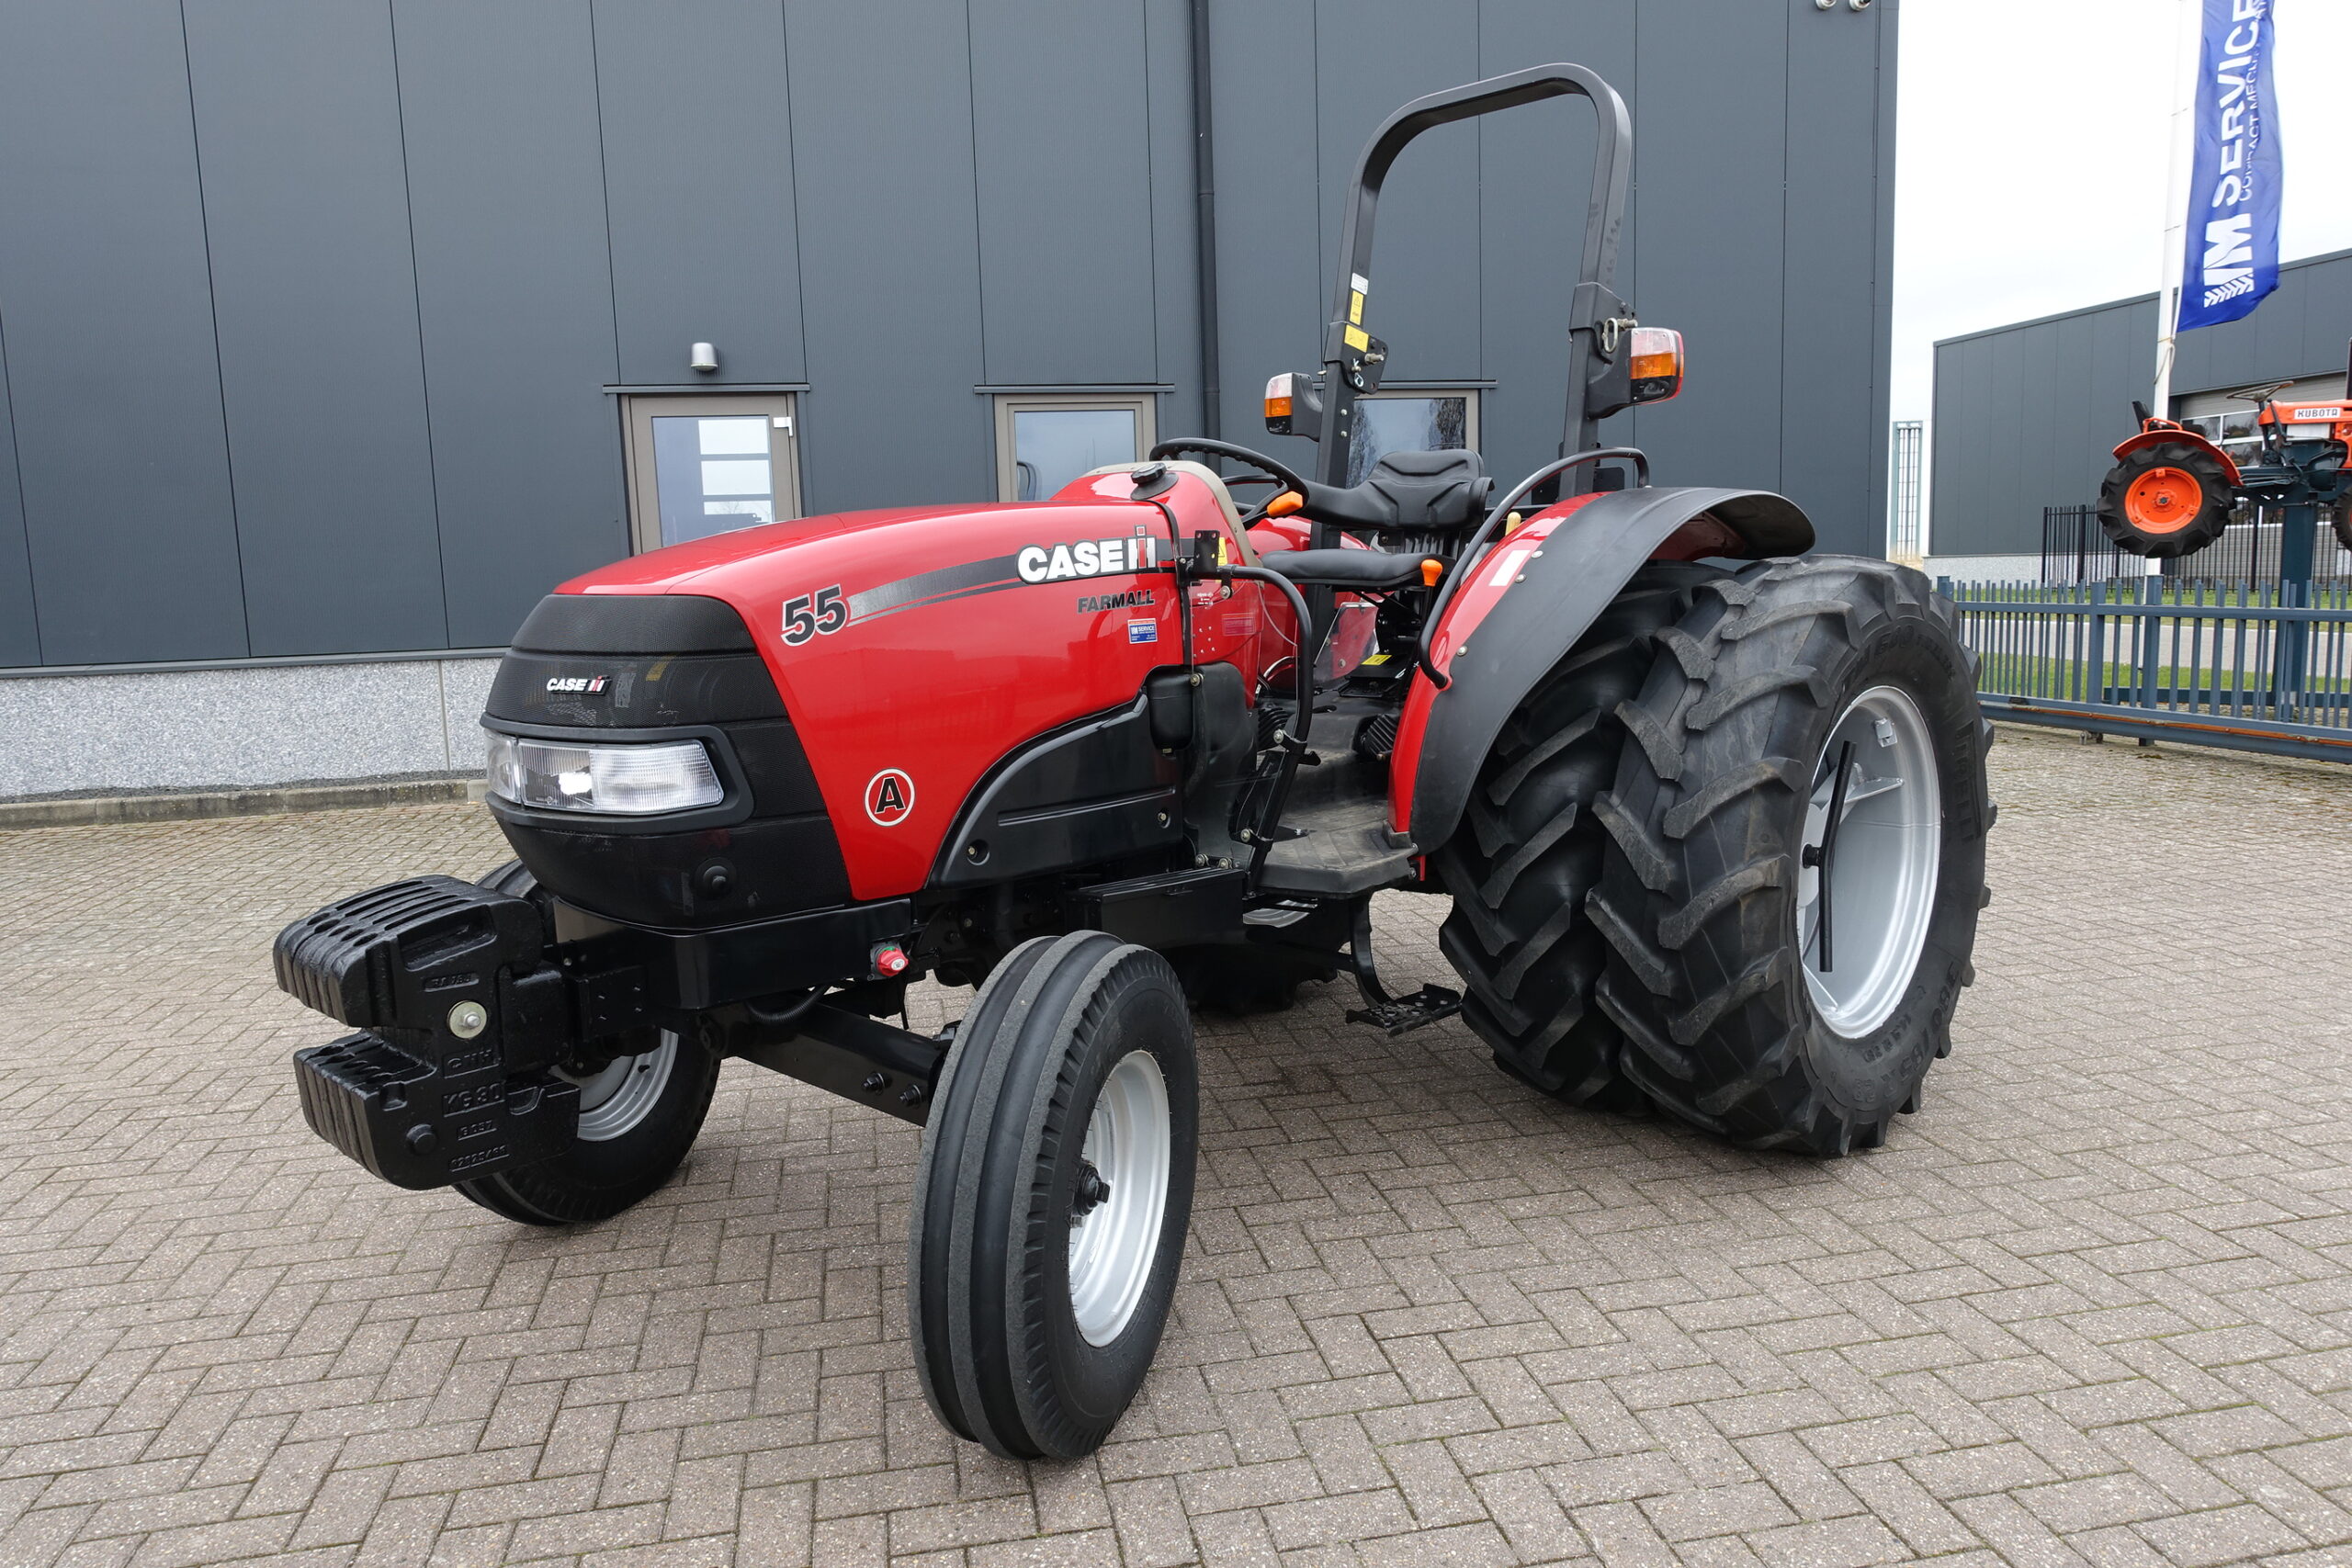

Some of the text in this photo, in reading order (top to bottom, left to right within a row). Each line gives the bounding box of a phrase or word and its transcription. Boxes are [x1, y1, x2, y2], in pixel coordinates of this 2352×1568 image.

[2211, 0, 2259, 208] SERVICE
[2297, 408, 2338, 418] KUBOTA
[1018, 538, 1124, 581] CASE
[781, 584, 849, 646] 55
[1077, 589, 1155, 614] FARMALL
[547, 678, 587, 693] CASE
[876, 776, 906, 814] A
